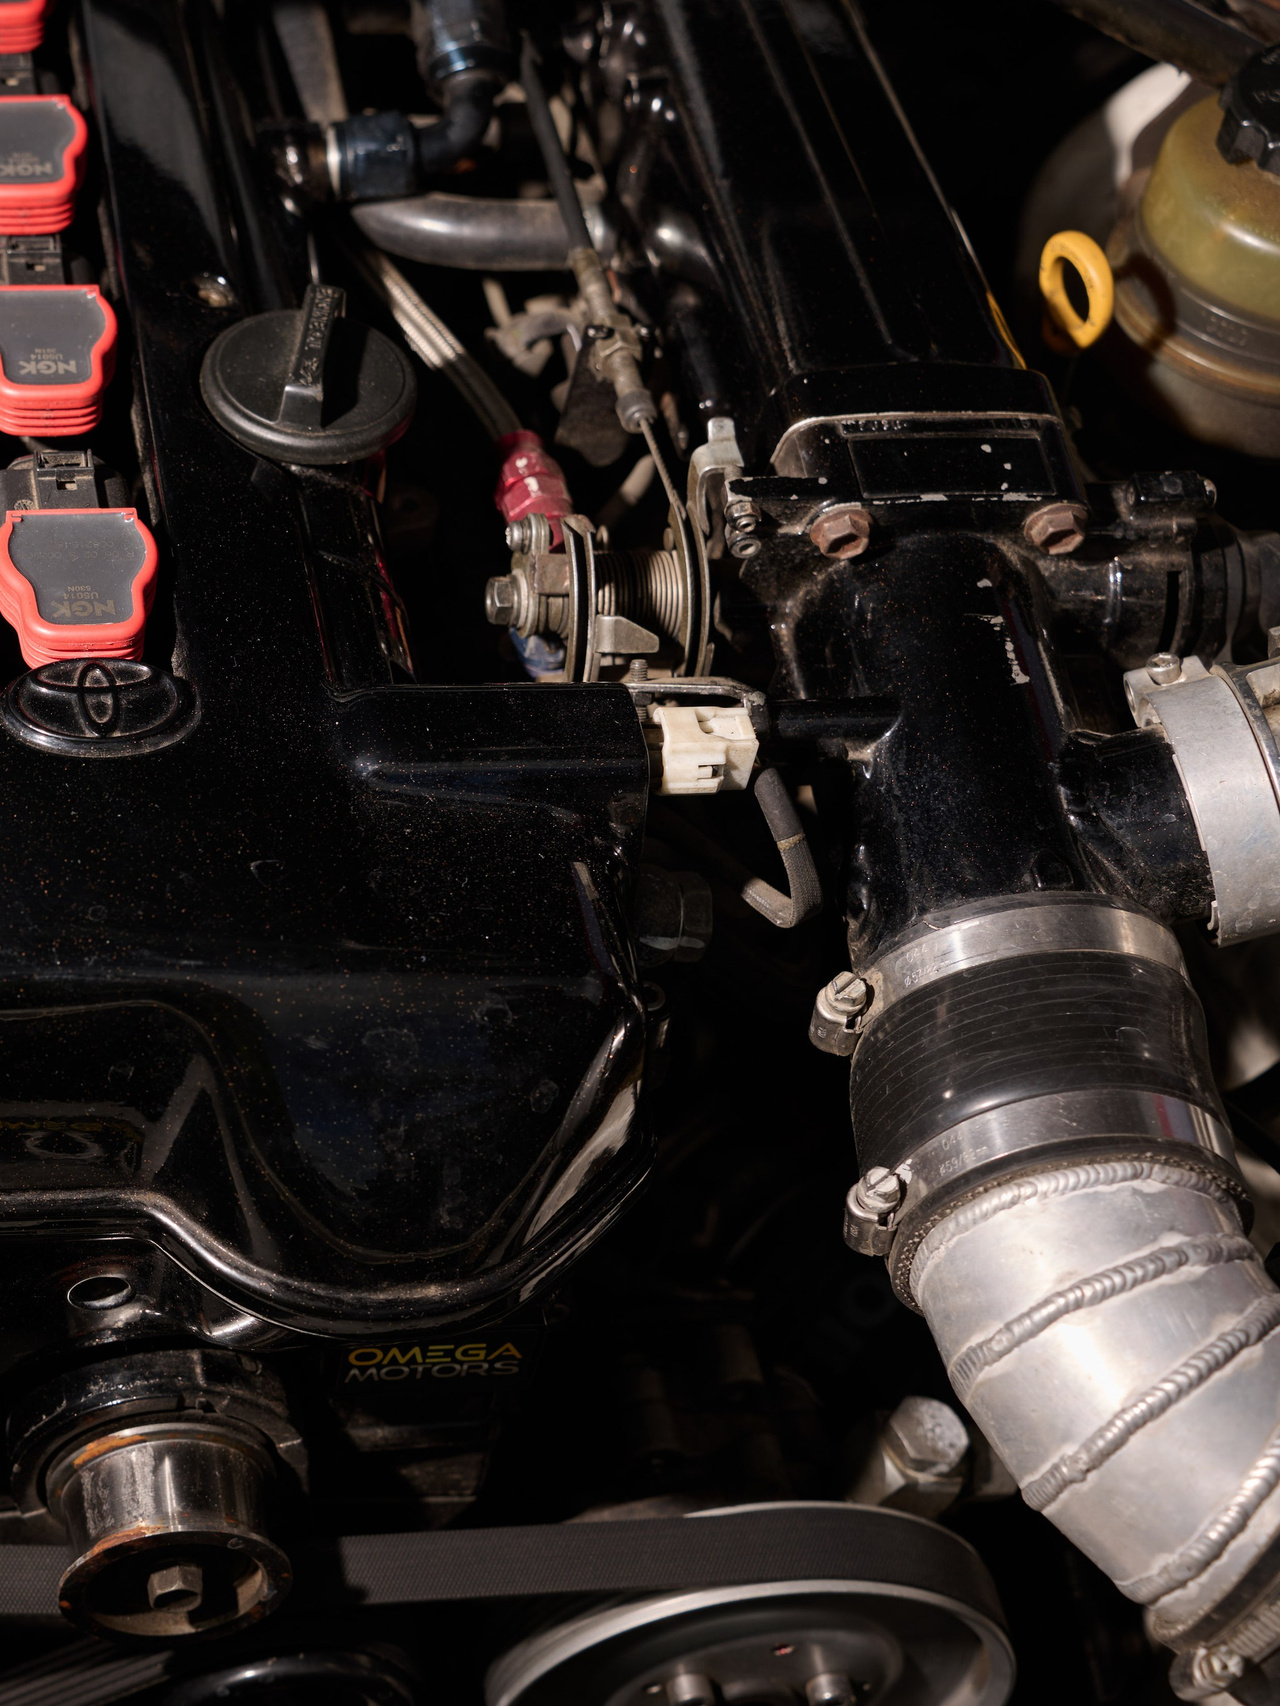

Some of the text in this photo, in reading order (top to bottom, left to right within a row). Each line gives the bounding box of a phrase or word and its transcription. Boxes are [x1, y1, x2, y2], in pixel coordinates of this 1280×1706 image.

[18, 360, 77, 375] NGK
[49, 600, 116, 618] NGK
[347, 1342, 523, 1366] OMEGA
[344, 1361, 520, 1384] MOTORS
